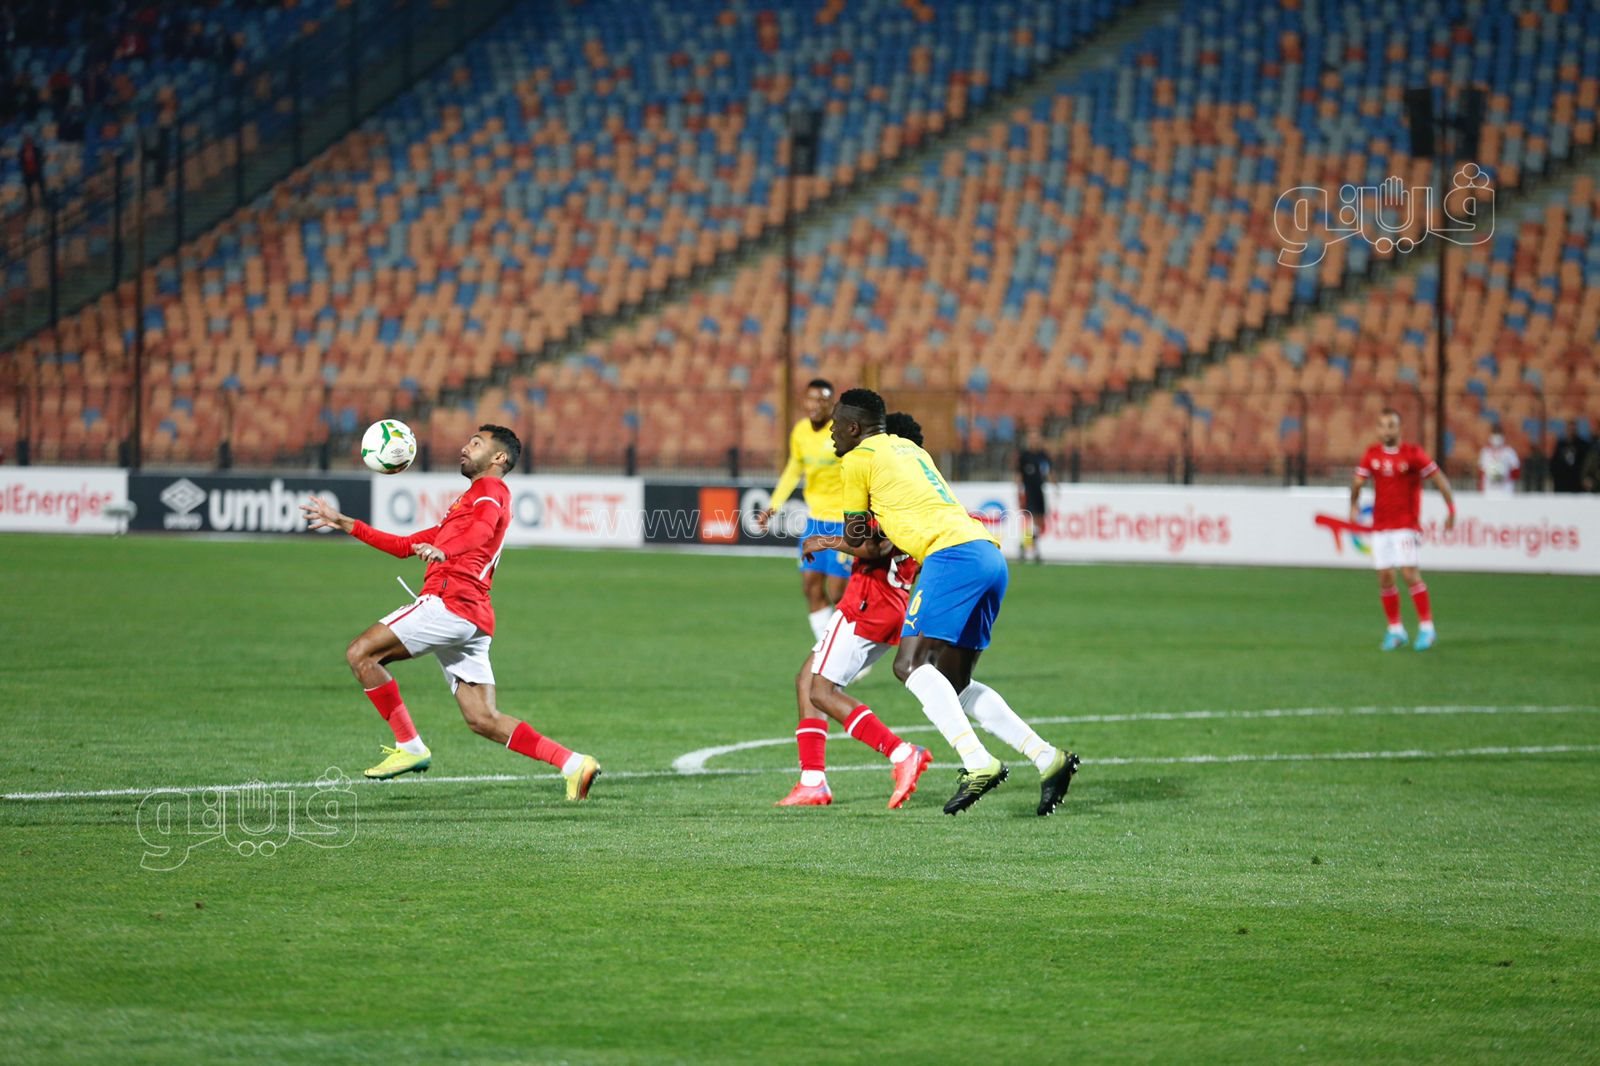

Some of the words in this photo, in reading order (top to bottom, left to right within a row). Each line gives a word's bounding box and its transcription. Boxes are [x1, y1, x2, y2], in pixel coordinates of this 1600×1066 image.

[208, 478, 340, 533] umbro
[512, 489, 625, 529] QNET
[908, 590, 923, 616] 6
